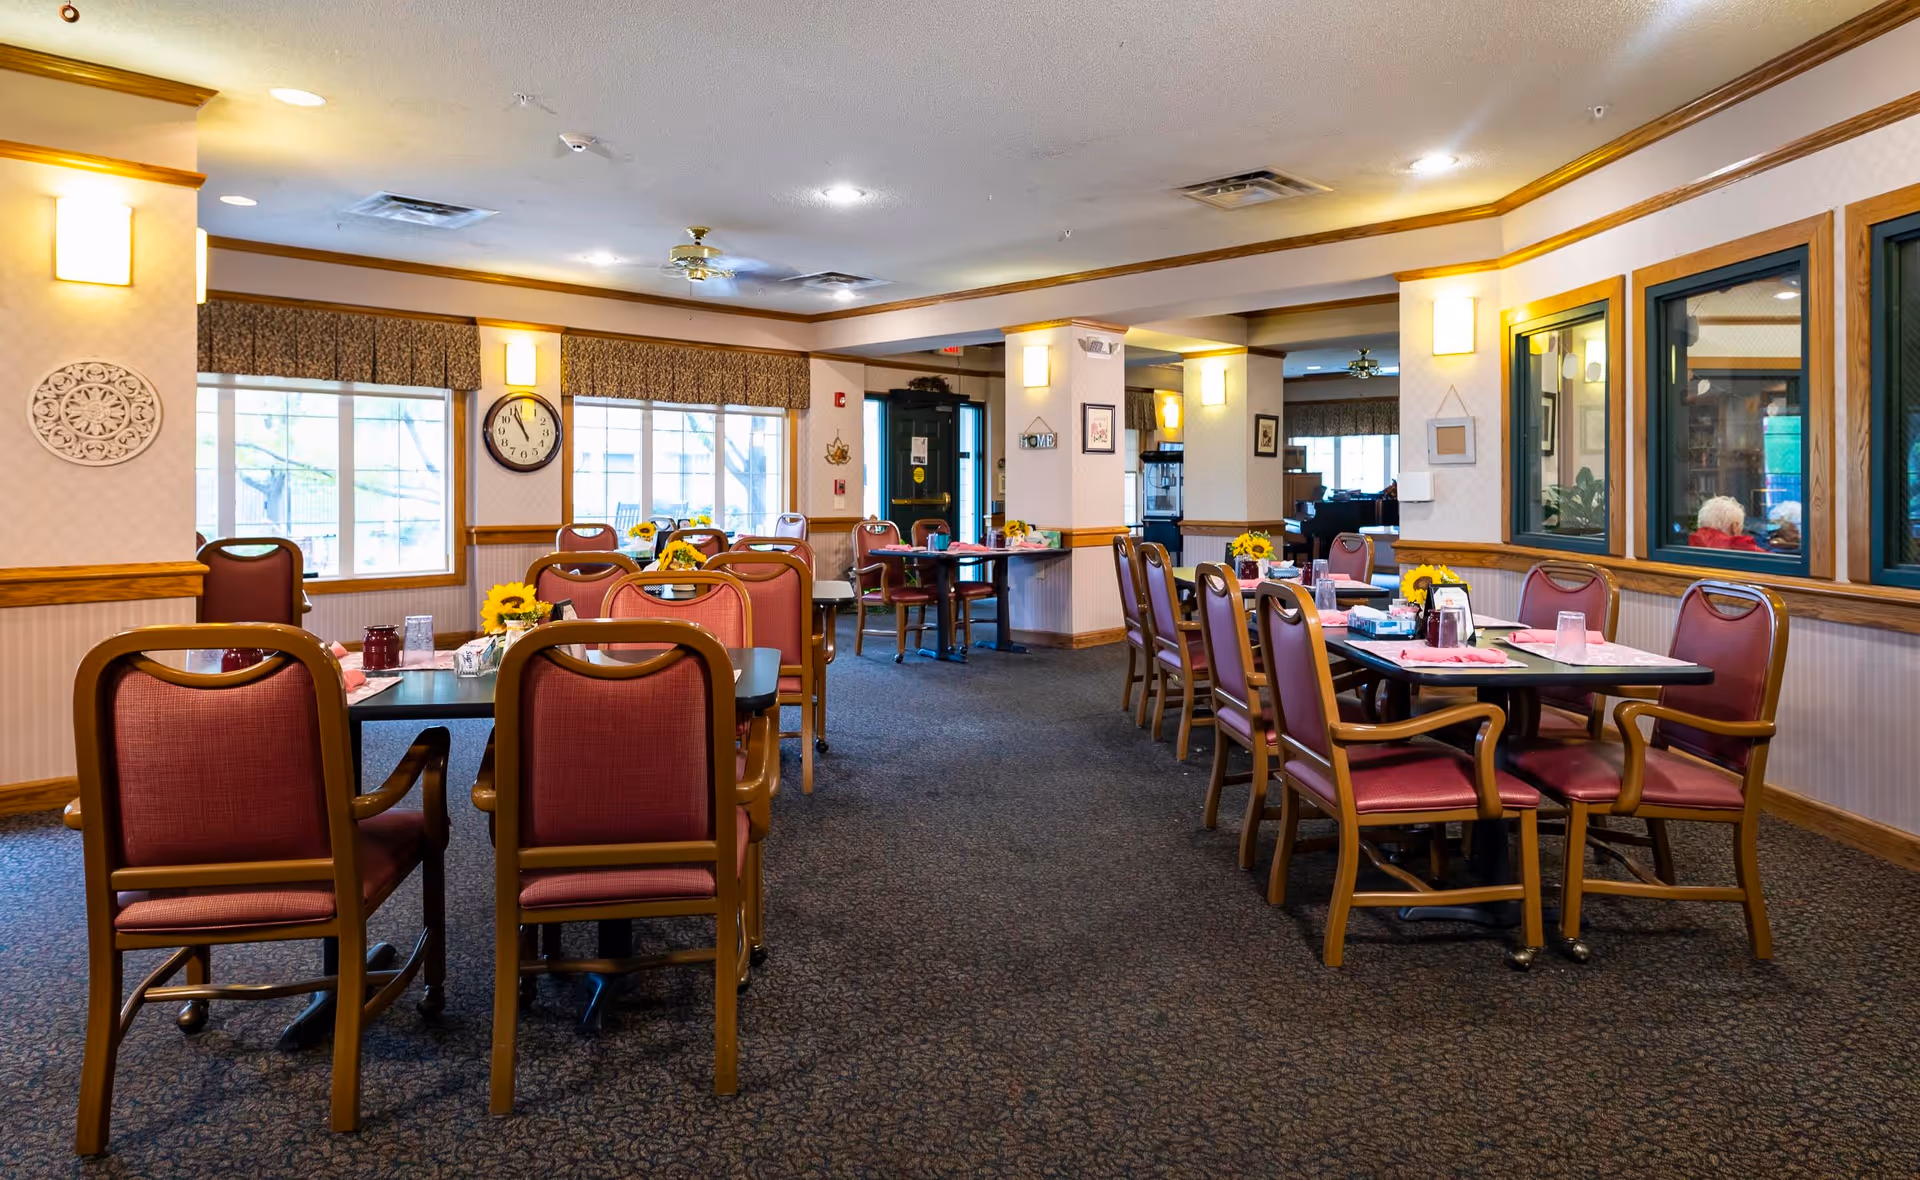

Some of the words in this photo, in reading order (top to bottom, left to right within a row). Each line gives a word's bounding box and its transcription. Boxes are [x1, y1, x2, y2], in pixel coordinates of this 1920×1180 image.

[501, 416, 511, 424] 10
[540, 417, 546, 426] 2
[498, 427, 506, 435] 9
[542, 429, 550, 437] 3
[501, 438, 509, 447] 8
[539, 439, 545, 447] 4
[1020, 433, 1055, 448] HOME
[509, 447, 516, 455] 7
[520, 450, 528, 459] 6
[531, 448, 539, 456] 5
